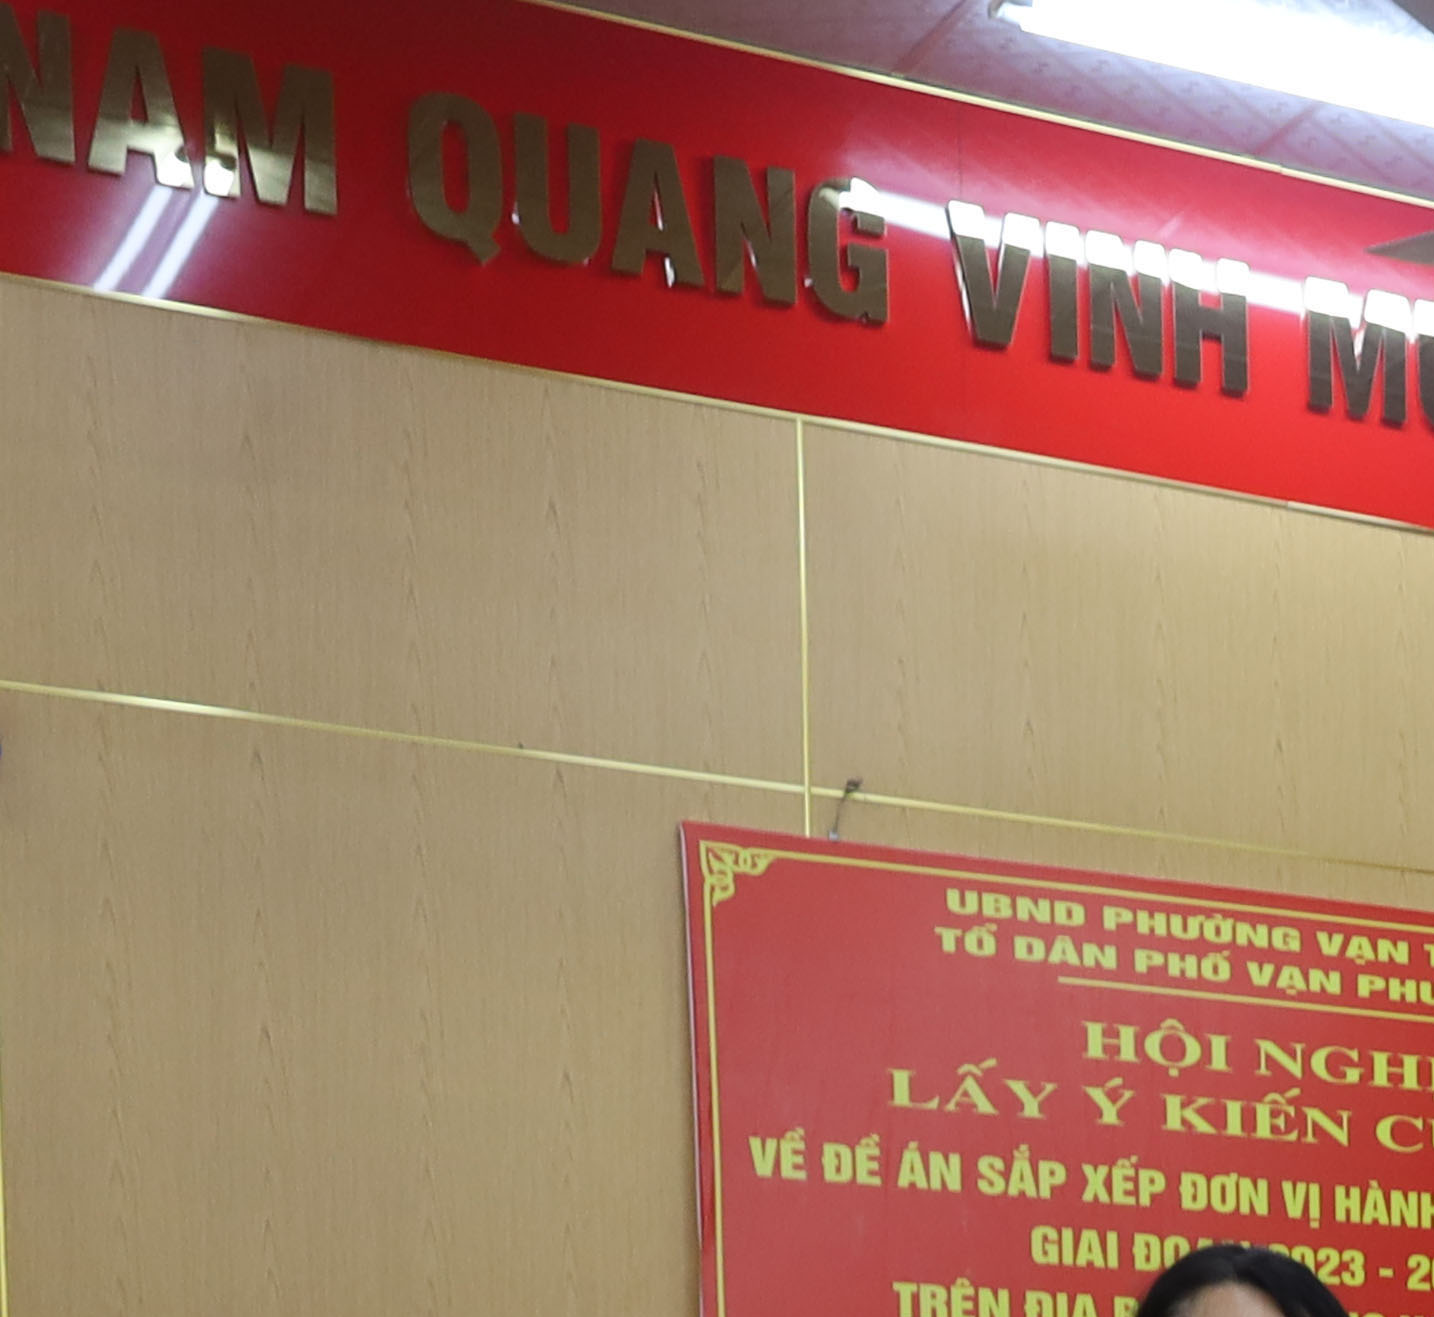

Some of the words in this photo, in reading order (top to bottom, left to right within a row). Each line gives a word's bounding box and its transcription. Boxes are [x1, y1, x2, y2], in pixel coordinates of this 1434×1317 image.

[0, 2, 338, 216] NAM
[407, 92, 889, 325] QUANG
[945, 199, 1249, 398] VINH
[946, 888, 1087, 928] UBND
[1101, 905, 1302, 952] PHƯỜNG
[1316, 931, 1409, 965] VẠN
[1013, 934, 1119, 971] DÂN
[1133, 948, 1232, 983] PHỐ
[1246, 961, 1342, 995] VẠN
[1082, 1018, 1231, 1077] HỘI
[888, 1057, 1057, 1119] LẤY
[1083, 1077, 1134, 1125] Ý
[1160, 1088, 1351, 1146] KIẾN
[748, 1128, 808, 1181] VỀ
[821, 1133, 883, 1187] ĐỀ
[897, 1141, 962, 1192] ÁN
[977, 1144, 1067, 1199] SẮP
[1082, 1155, 1167, 1207] XẾP
[1179, 1172, 1269, 1216] ĐƠN
[1282, 1180, 1320, 1228] VỊ
[1031, 1225, 1119, 1269] GIAI
